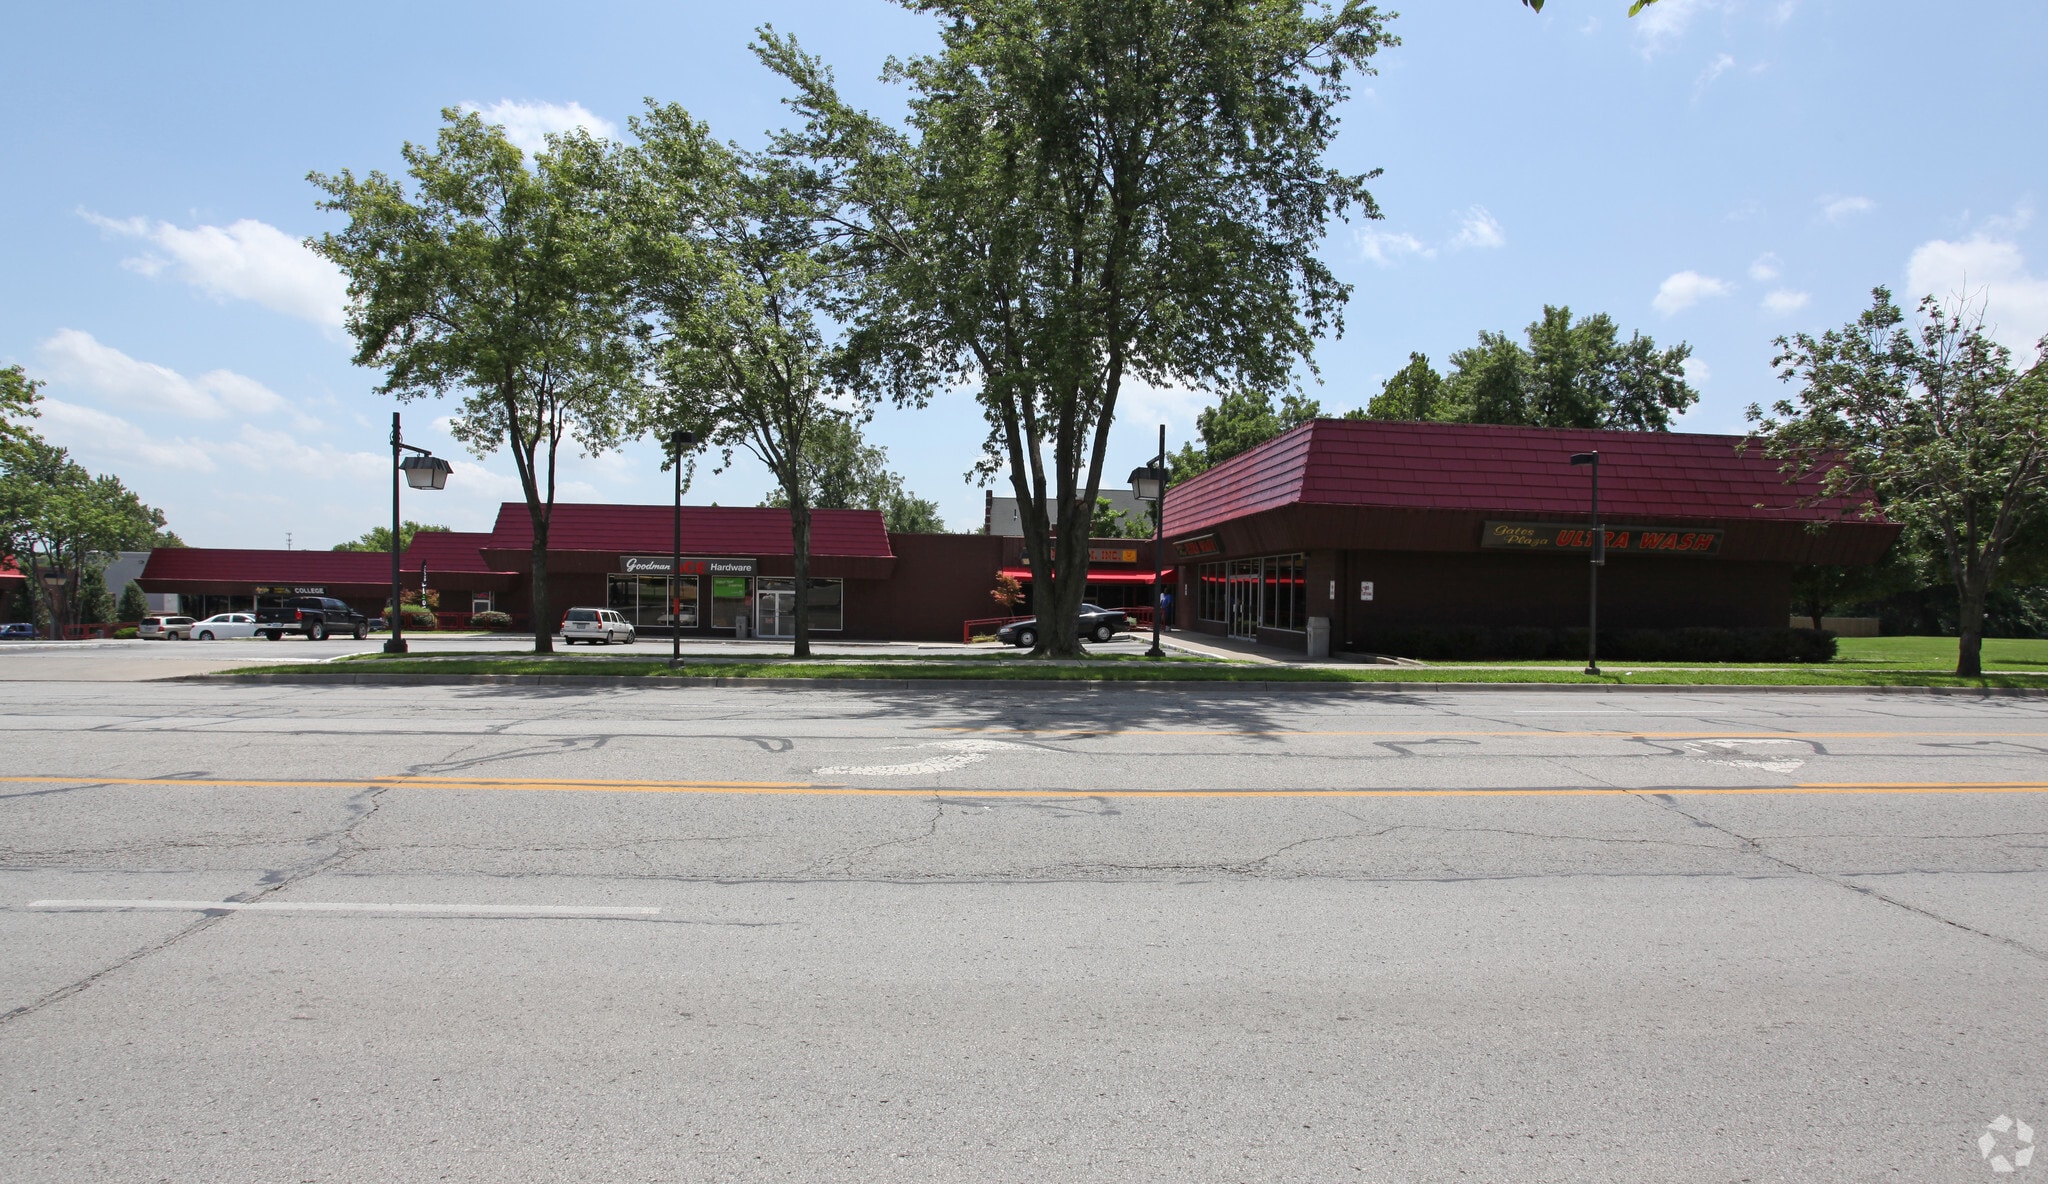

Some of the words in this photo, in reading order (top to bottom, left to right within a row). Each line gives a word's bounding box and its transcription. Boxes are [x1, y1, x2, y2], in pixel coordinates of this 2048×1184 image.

[1493, 524, 1535, 536] Gates
[1503, 535, 1550, 548] Plaza
[1639, 532, 1715, 551] WASH
[626, 558, 671, 573] Goodman
[710, 563, 752, 572] Hardware
